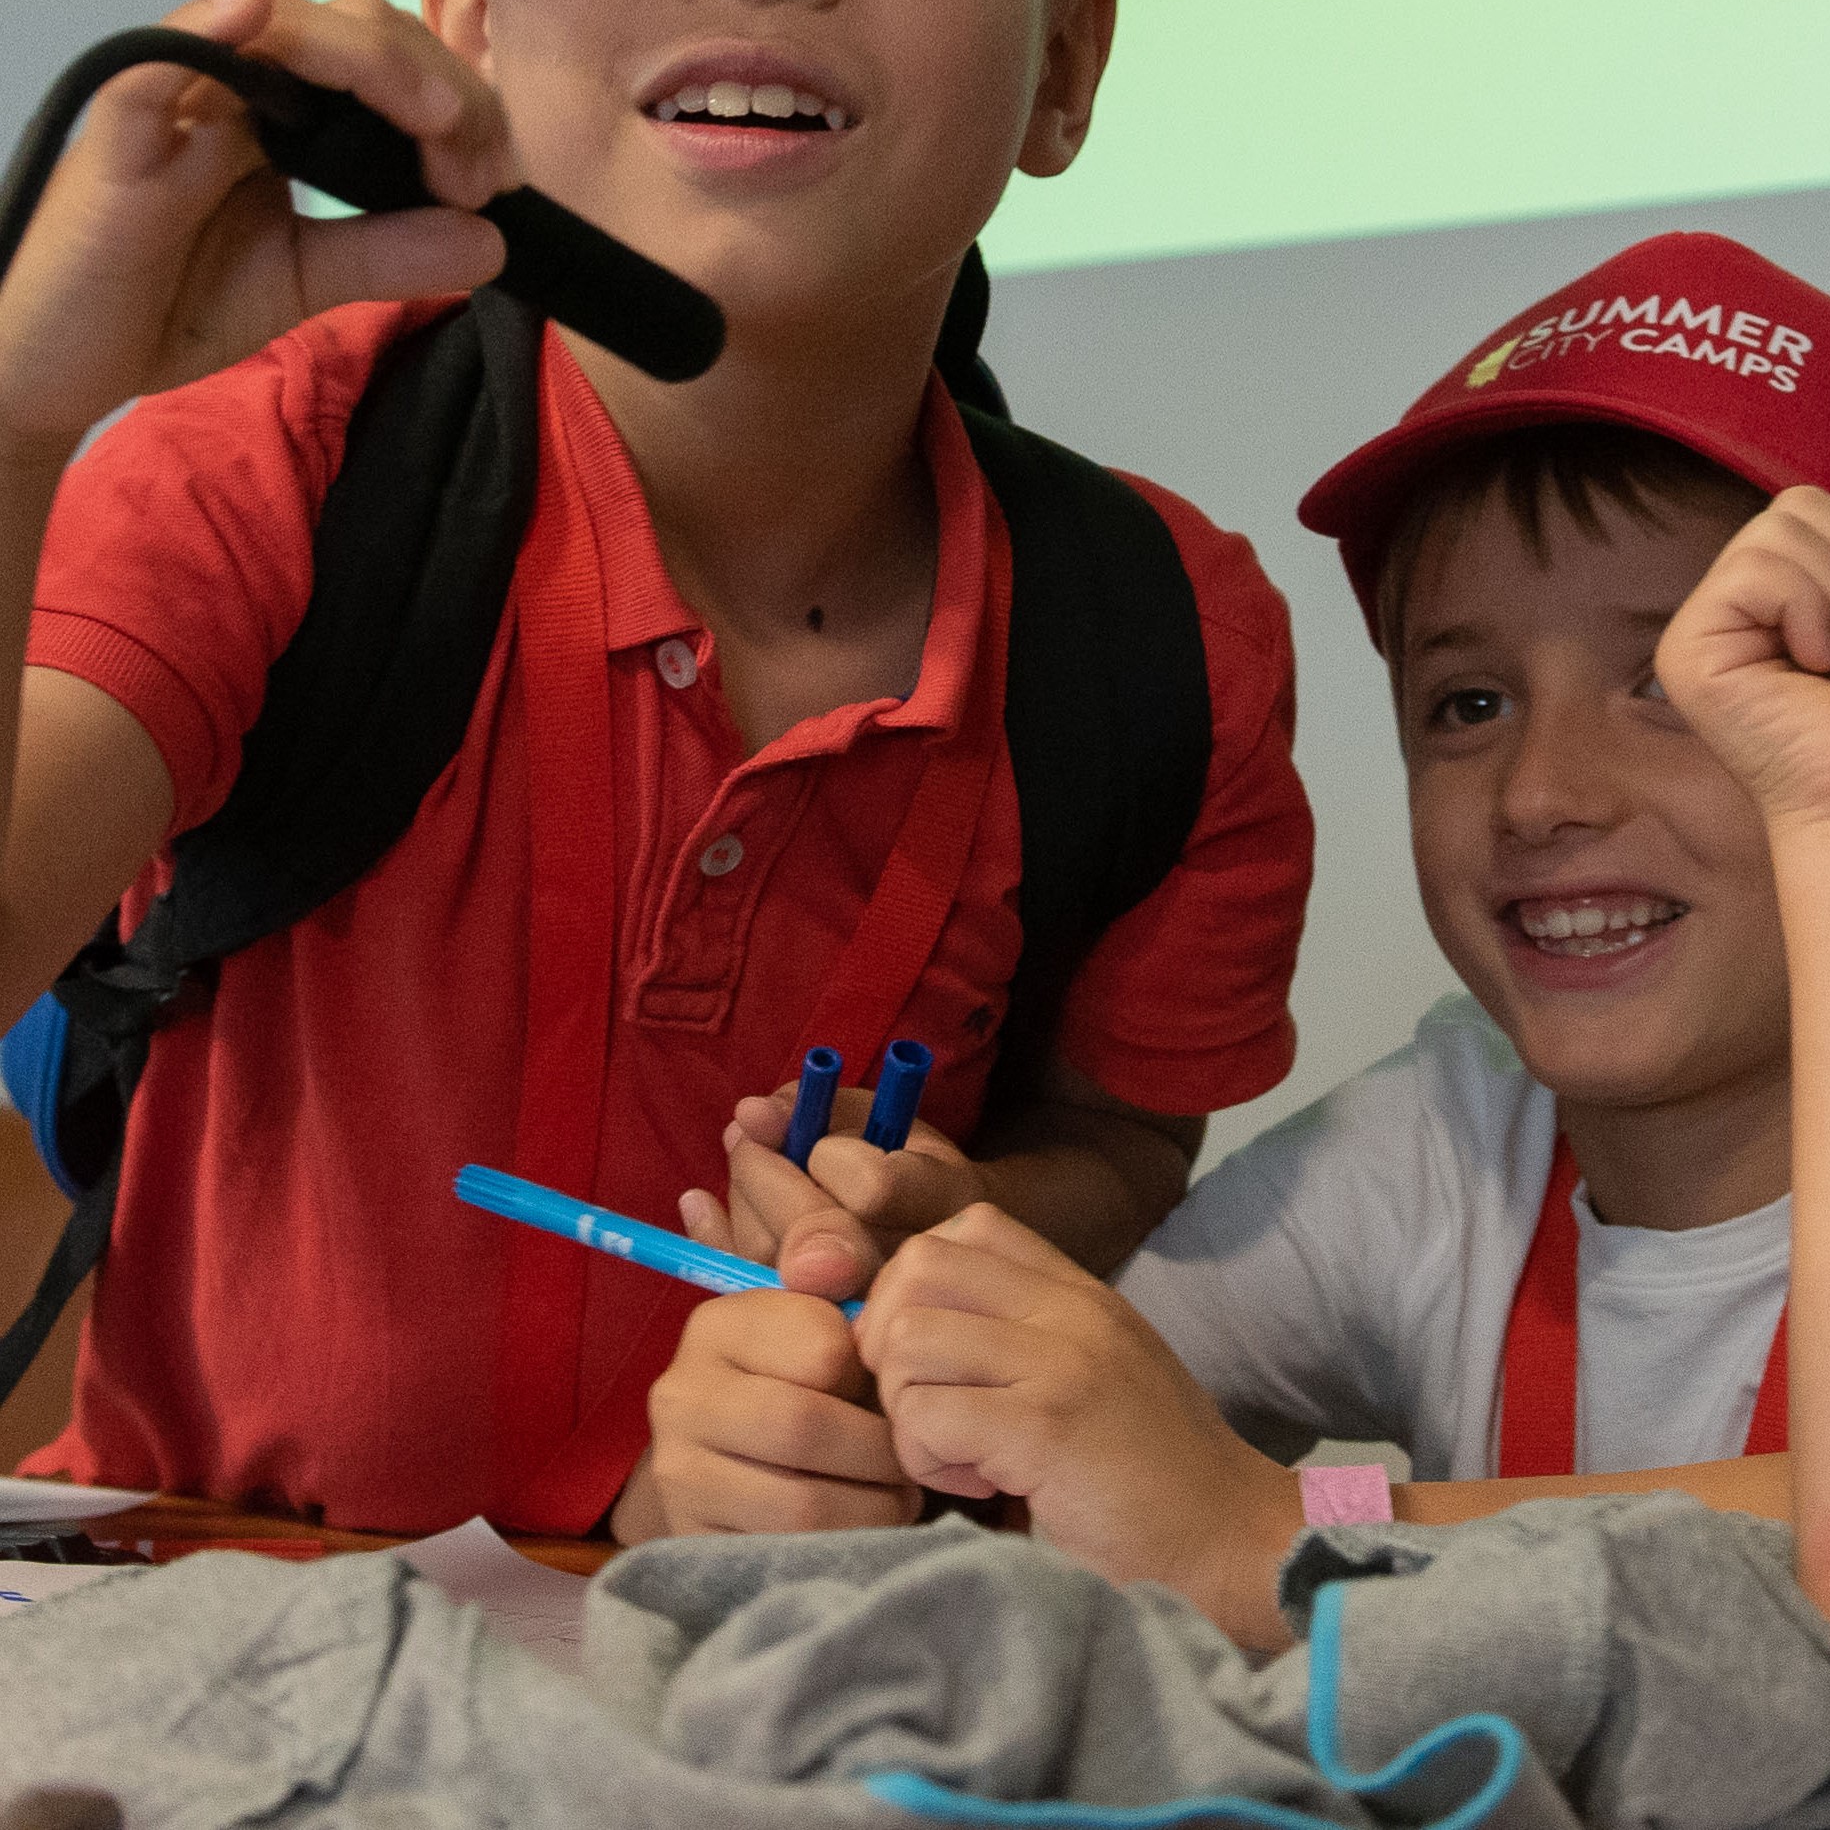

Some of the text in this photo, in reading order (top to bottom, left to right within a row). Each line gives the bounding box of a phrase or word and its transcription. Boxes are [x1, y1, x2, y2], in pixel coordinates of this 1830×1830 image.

[1508, 328, 1800, 394] CITY CAMPS
[1520, 295, 1814, 366] SUMMER
